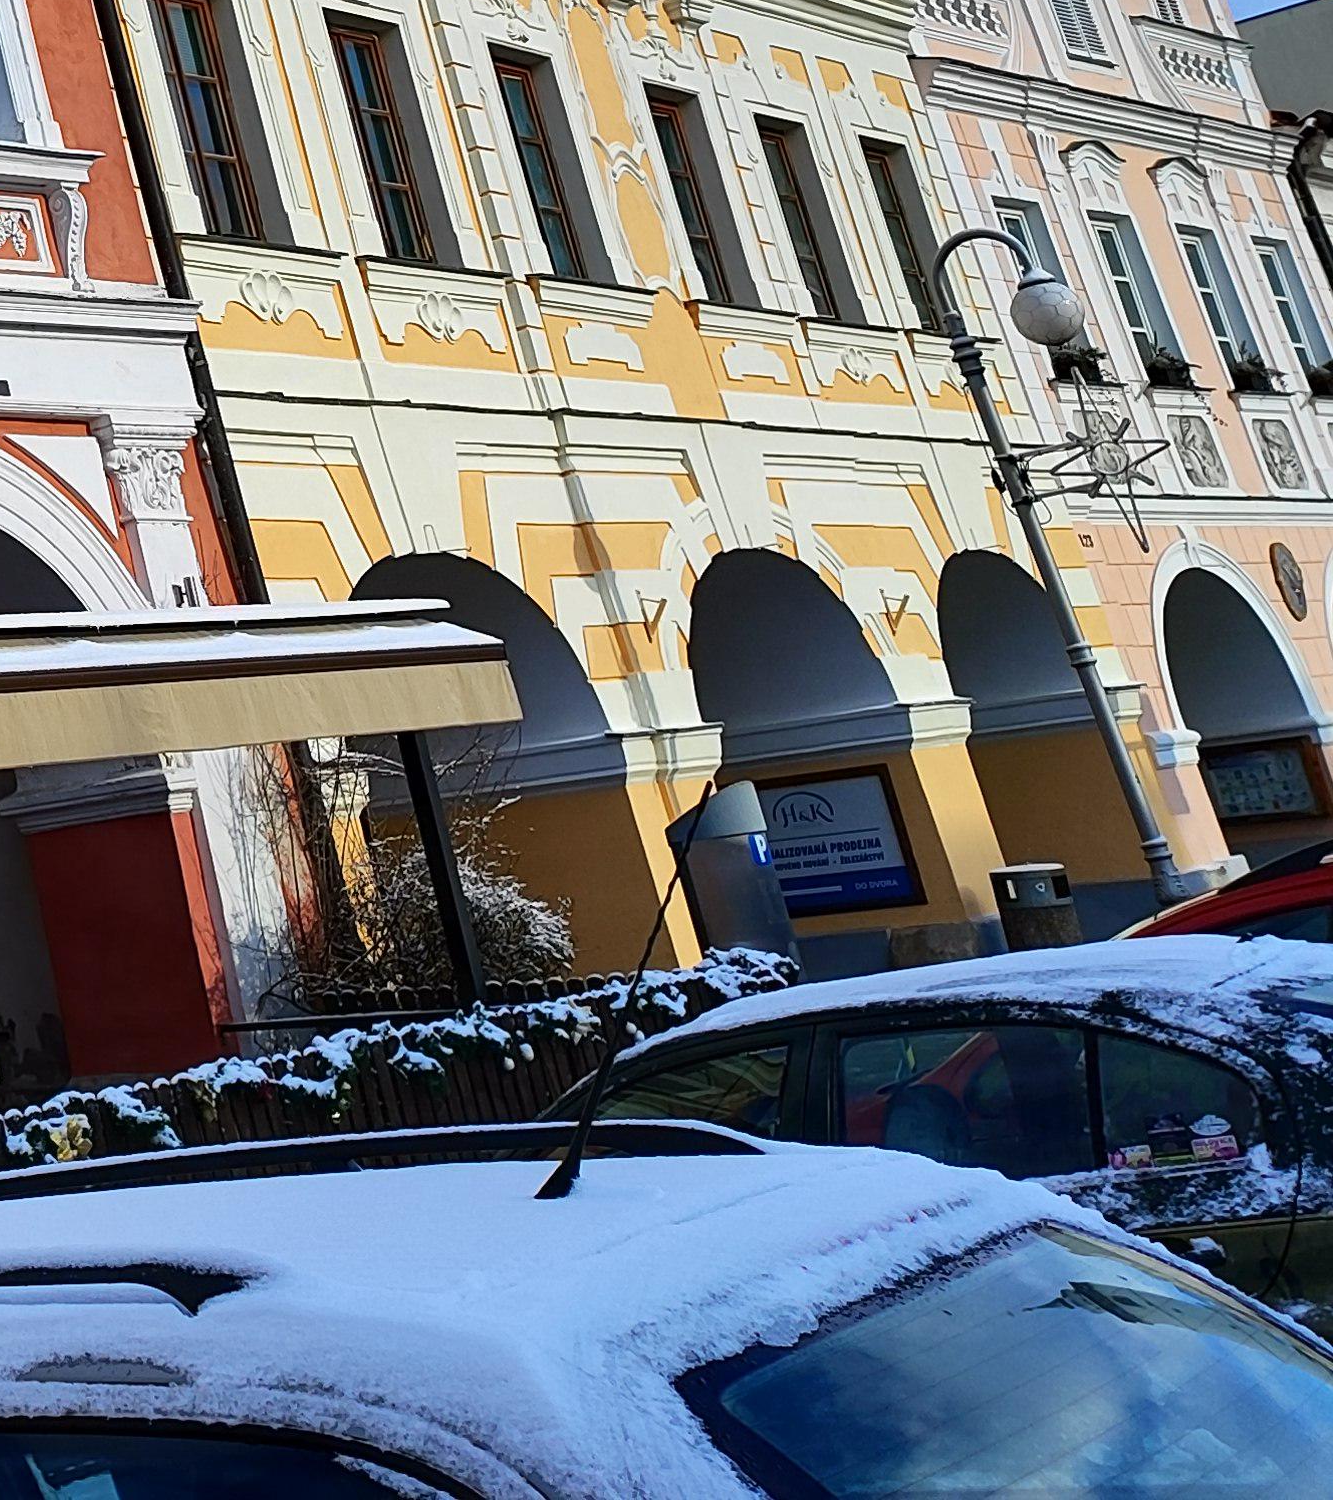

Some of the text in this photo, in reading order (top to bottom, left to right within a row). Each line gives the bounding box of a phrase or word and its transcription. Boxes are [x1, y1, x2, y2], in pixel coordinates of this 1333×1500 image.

[1078, 533, 1094, 548] 123
[781, 803, 834, 828] H&K
[754, 834, 767, 863] P
[830, 836, 882, 853] PRODEJNA
[869, 879, 899, 888] DVORA
